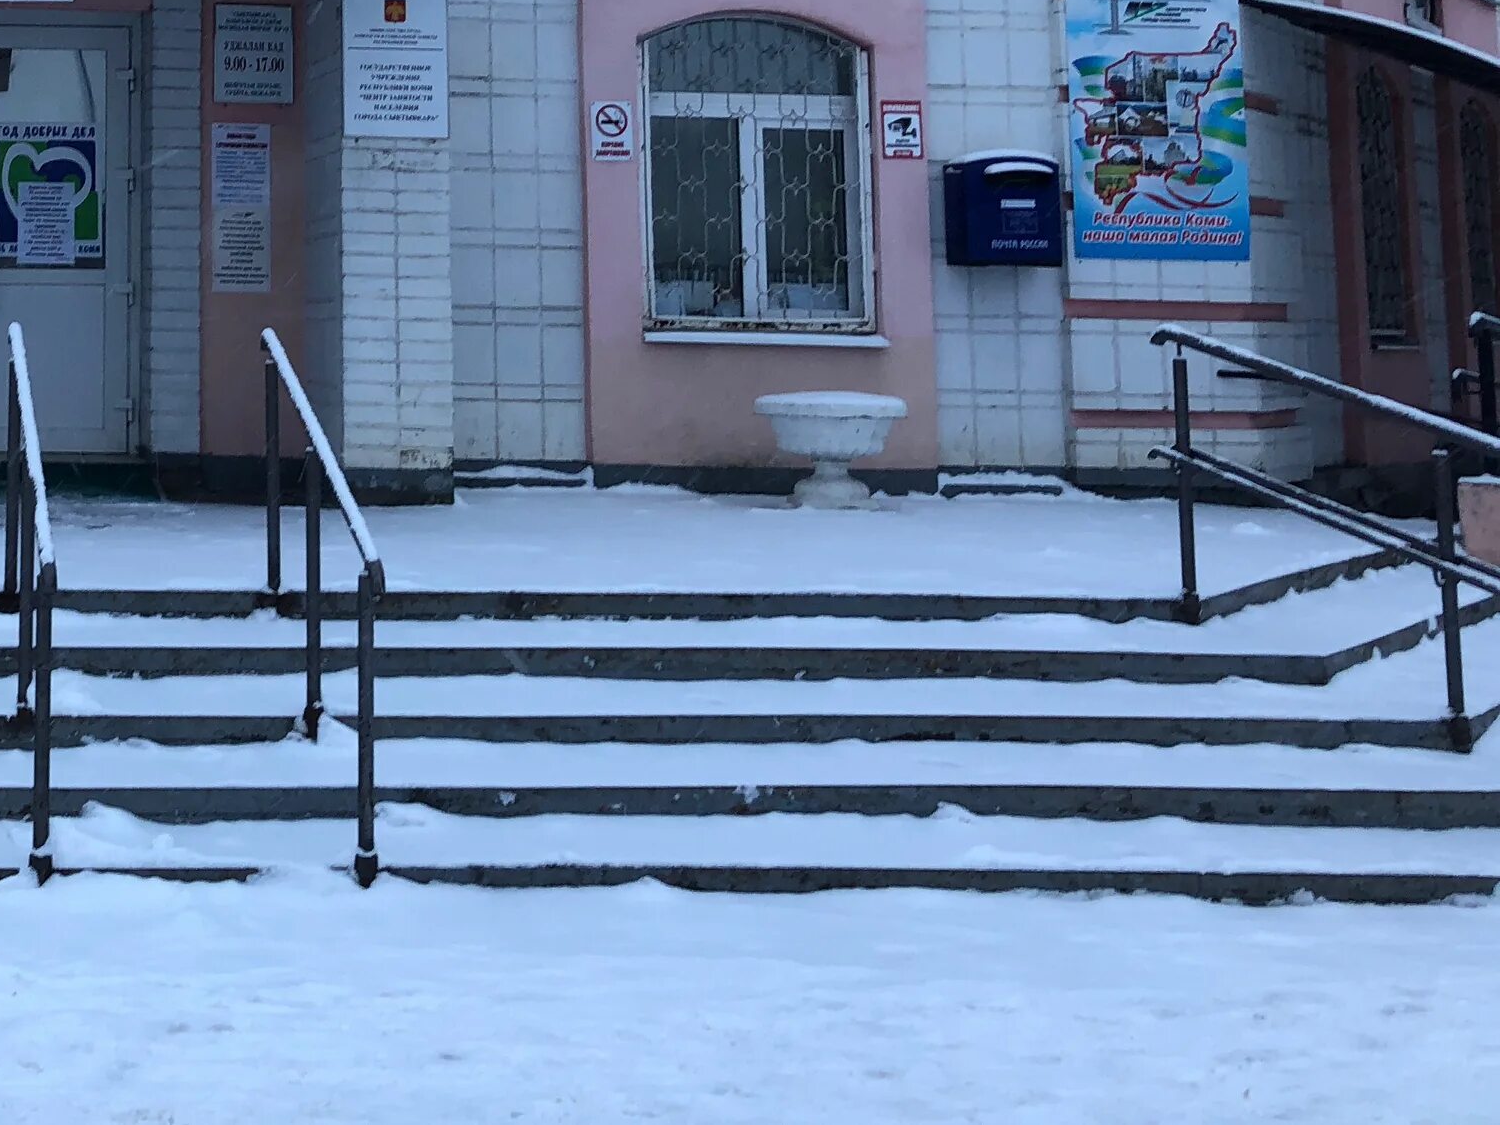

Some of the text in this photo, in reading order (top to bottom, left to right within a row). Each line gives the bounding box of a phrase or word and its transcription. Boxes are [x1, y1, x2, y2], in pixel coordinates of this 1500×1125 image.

[224, 56, 247, 72] 9.00
[255, 56, 285, 73] 17.00
[22, 125, 68, 139] ДОБРЫХ
[71, 126, 96, 139] ДЕЛ
[1093, 212, 1232, 228] Республика Коми-
[991, 239, 1049, 250] ПОЧТА РОССИИ
[1082, 229, 1243, 245] наша малая Родина!
